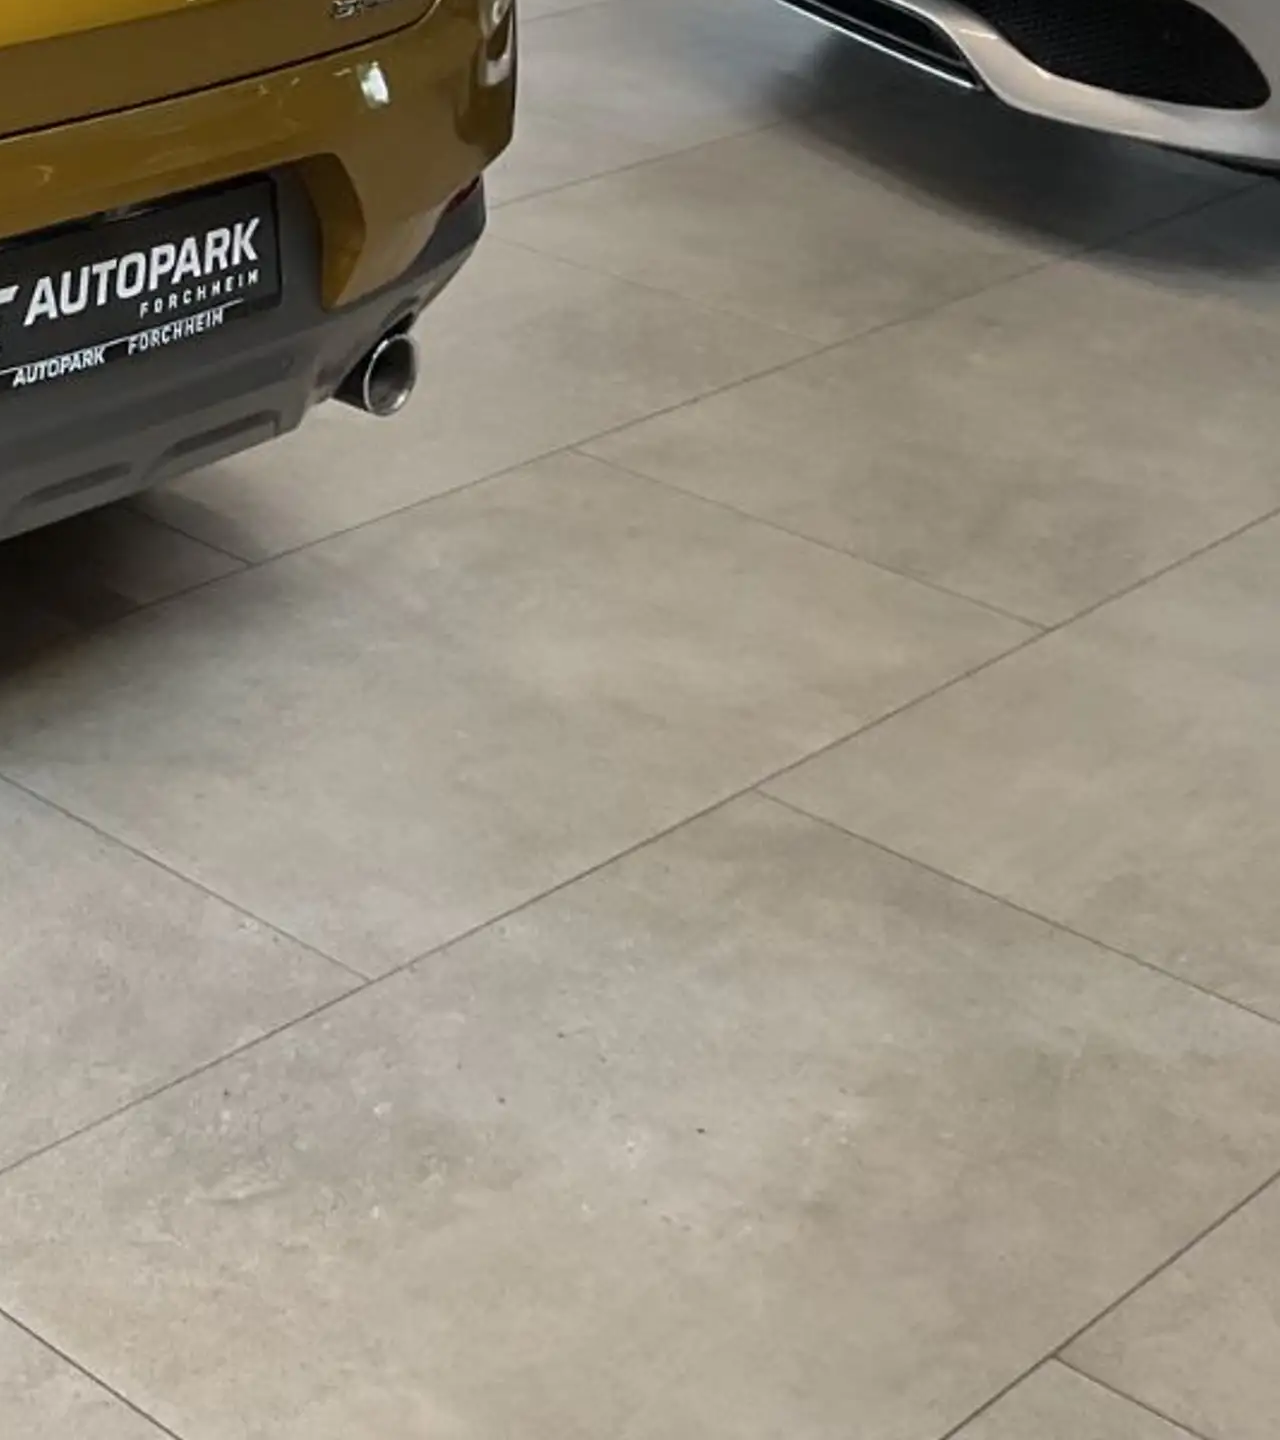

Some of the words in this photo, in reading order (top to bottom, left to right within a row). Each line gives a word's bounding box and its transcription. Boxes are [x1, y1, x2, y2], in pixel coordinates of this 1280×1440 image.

[23, 217, 261, 327] AUTOPARK
[140, 268, 260, 320] FORCHHEIM
[12, 346, 106, 388] AUTOPARK
[127, 308, 225, 357] FORCHHEIM
